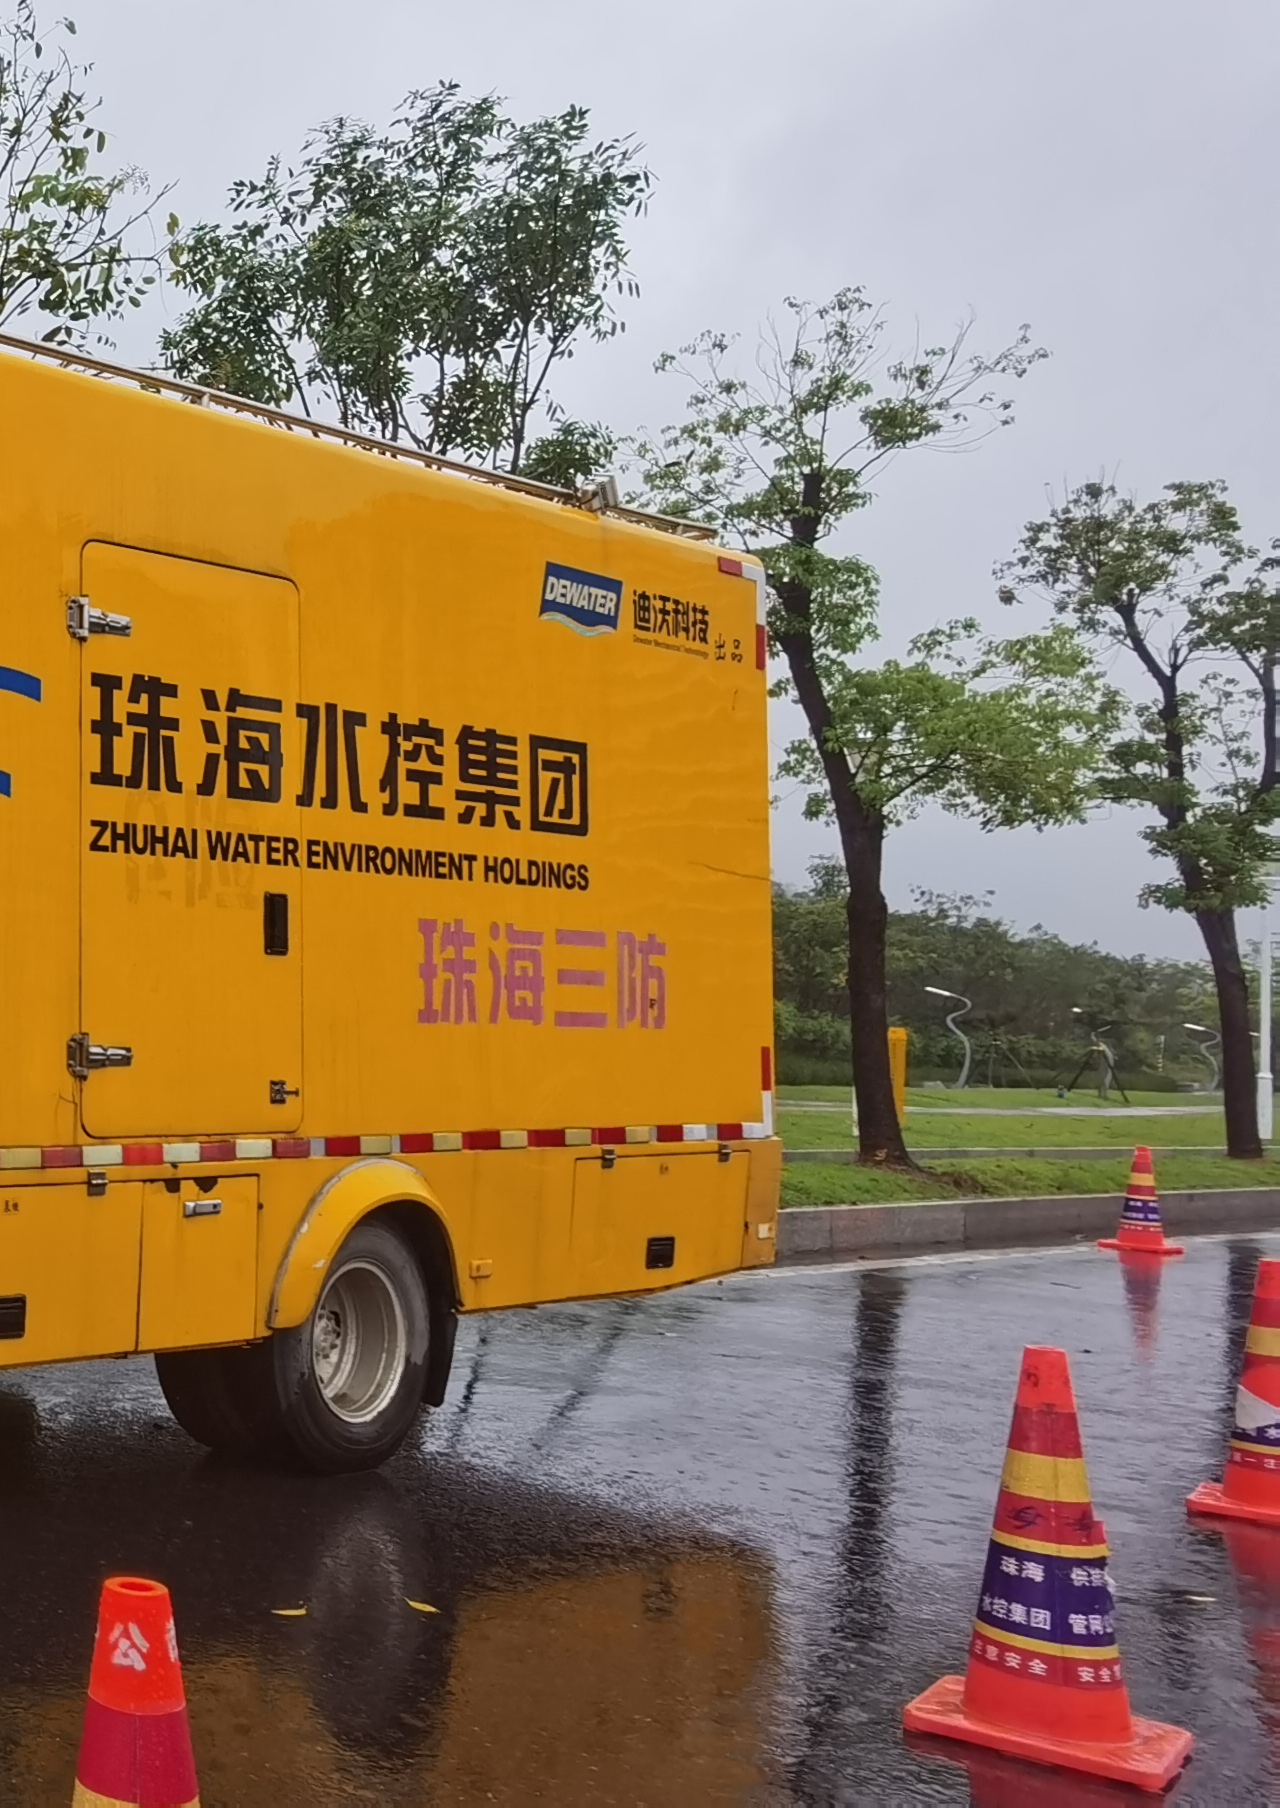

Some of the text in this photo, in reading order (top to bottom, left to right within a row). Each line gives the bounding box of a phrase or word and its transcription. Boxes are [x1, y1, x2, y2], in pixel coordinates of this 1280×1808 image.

[544, 575, 618, 617] DEWATER
[632, 588, 710, 645] 迪沃科技
[714, 633, 744, 663] 出品
[90, 671, 589, 837] 珠海水控集团
[88, 819, 590, 892] ZHUHAI WATER ENVIRONMENT HOLDINGS
[417, 917, 667, 1030] 珠海三防
[999, 1555, 1045, 1584] 珠海
